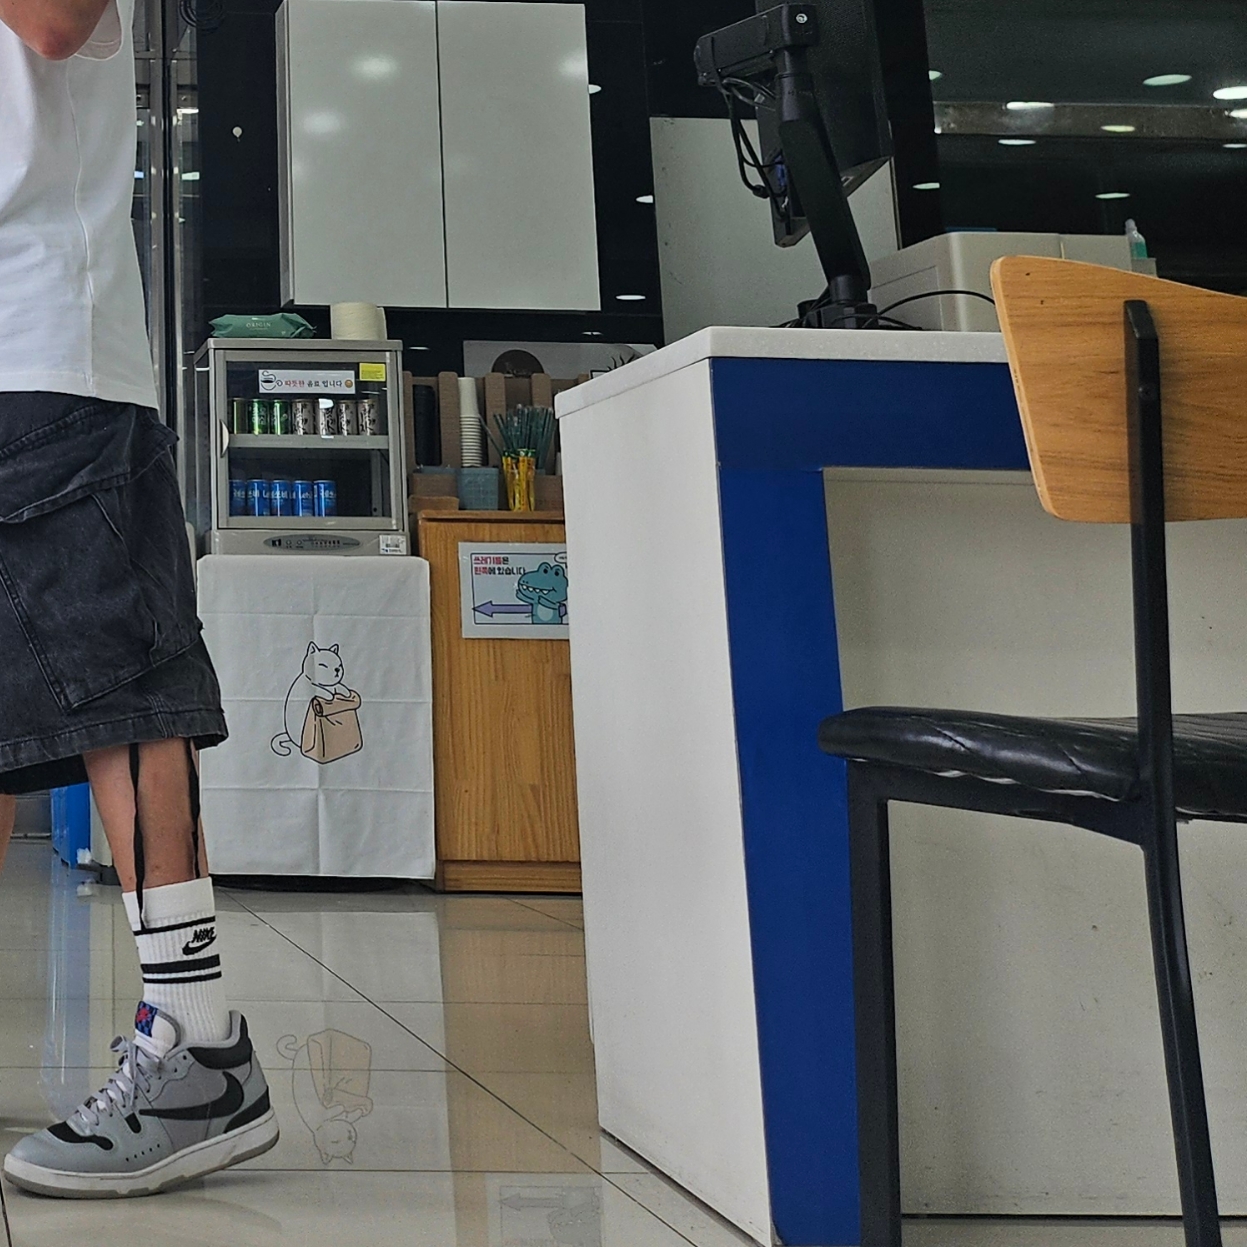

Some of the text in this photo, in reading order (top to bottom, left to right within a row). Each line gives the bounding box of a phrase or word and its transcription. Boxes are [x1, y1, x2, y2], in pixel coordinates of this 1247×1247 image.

[307, 379, 320, 388] 음료
[321, 379, 343, 388] 입니다
[191, 926, 215, 943] NIKE
